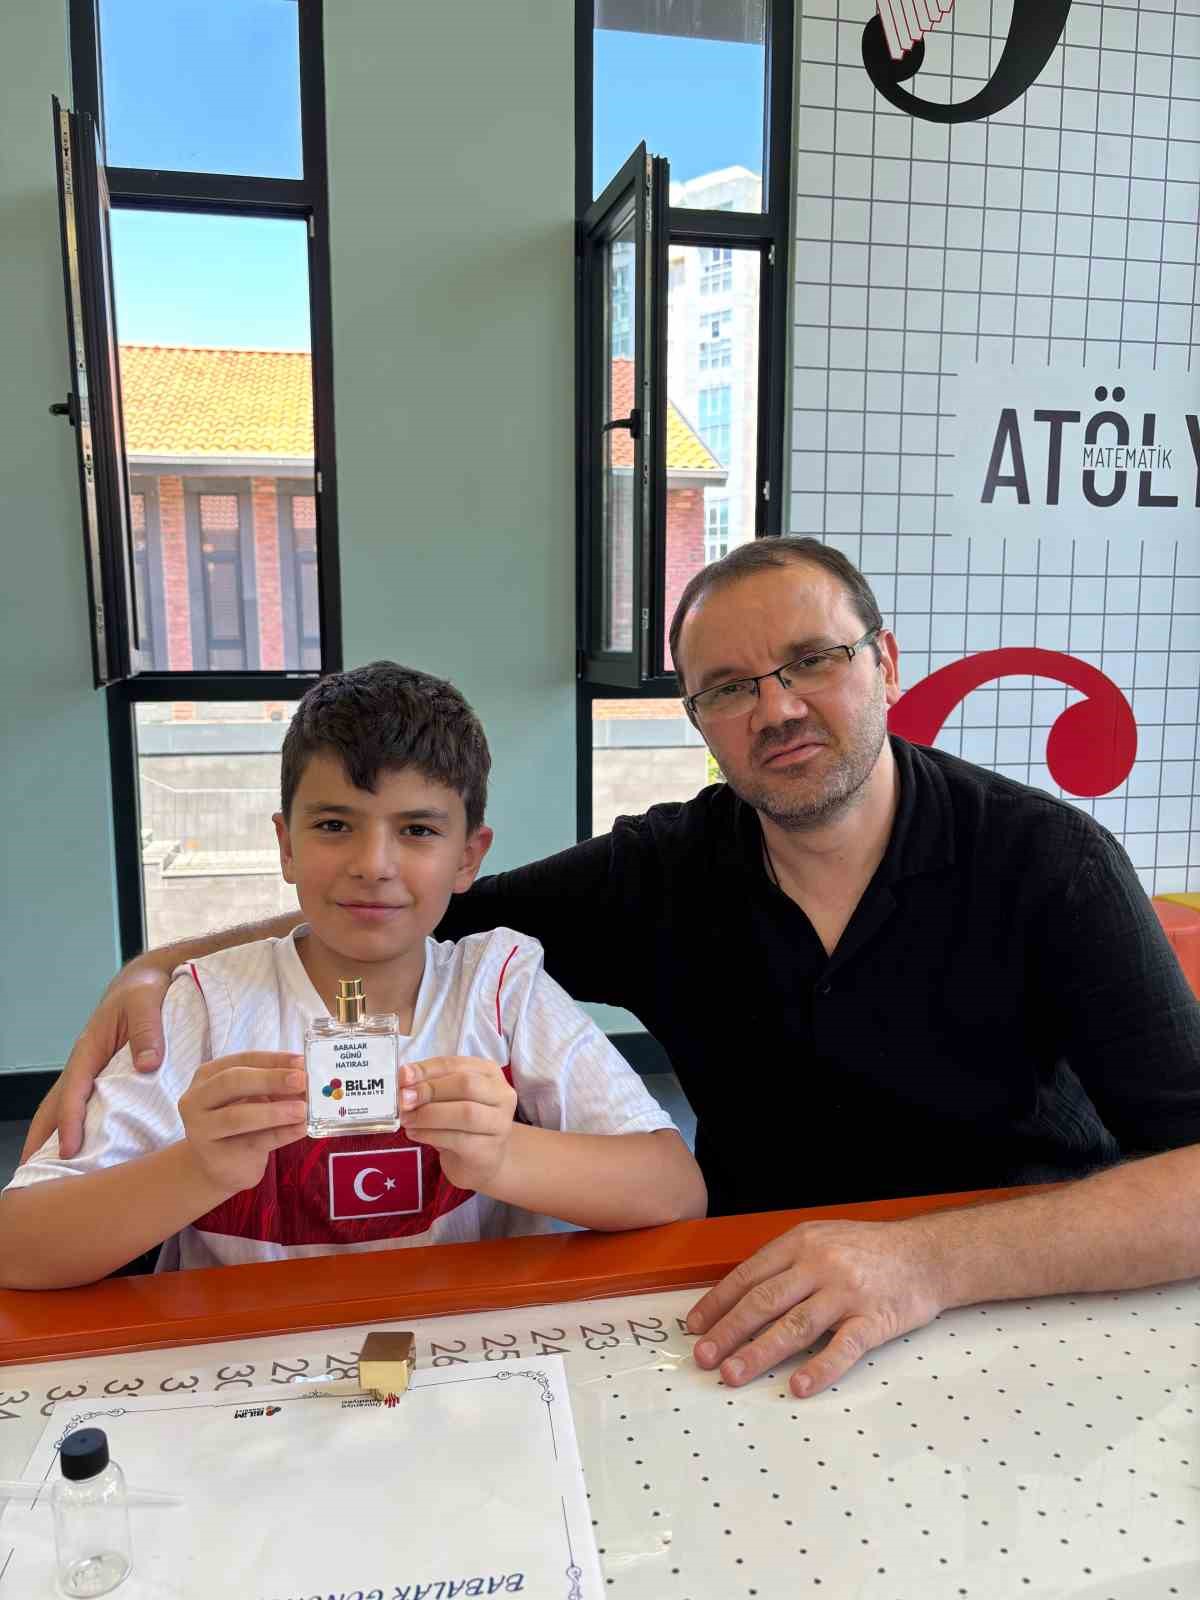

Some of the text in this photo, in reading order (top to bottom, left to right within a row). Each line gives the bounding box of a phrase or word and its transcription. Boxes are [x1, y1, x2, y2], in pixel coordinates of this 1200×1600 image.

[1082, 444, 1173, 470] MATEMATİK
[334, 1043, 367, 1052] BABALAR
[340, 1051, 362, 1060] GÜNÜ
[430, 1340, 469, 1367] 26
[480, 1333, 520, 1361] 25
[529, 1327, 571, 1356] 24
[579, 1322, 620, 1351] 23
[626, 1317, 669, 1346] 22
